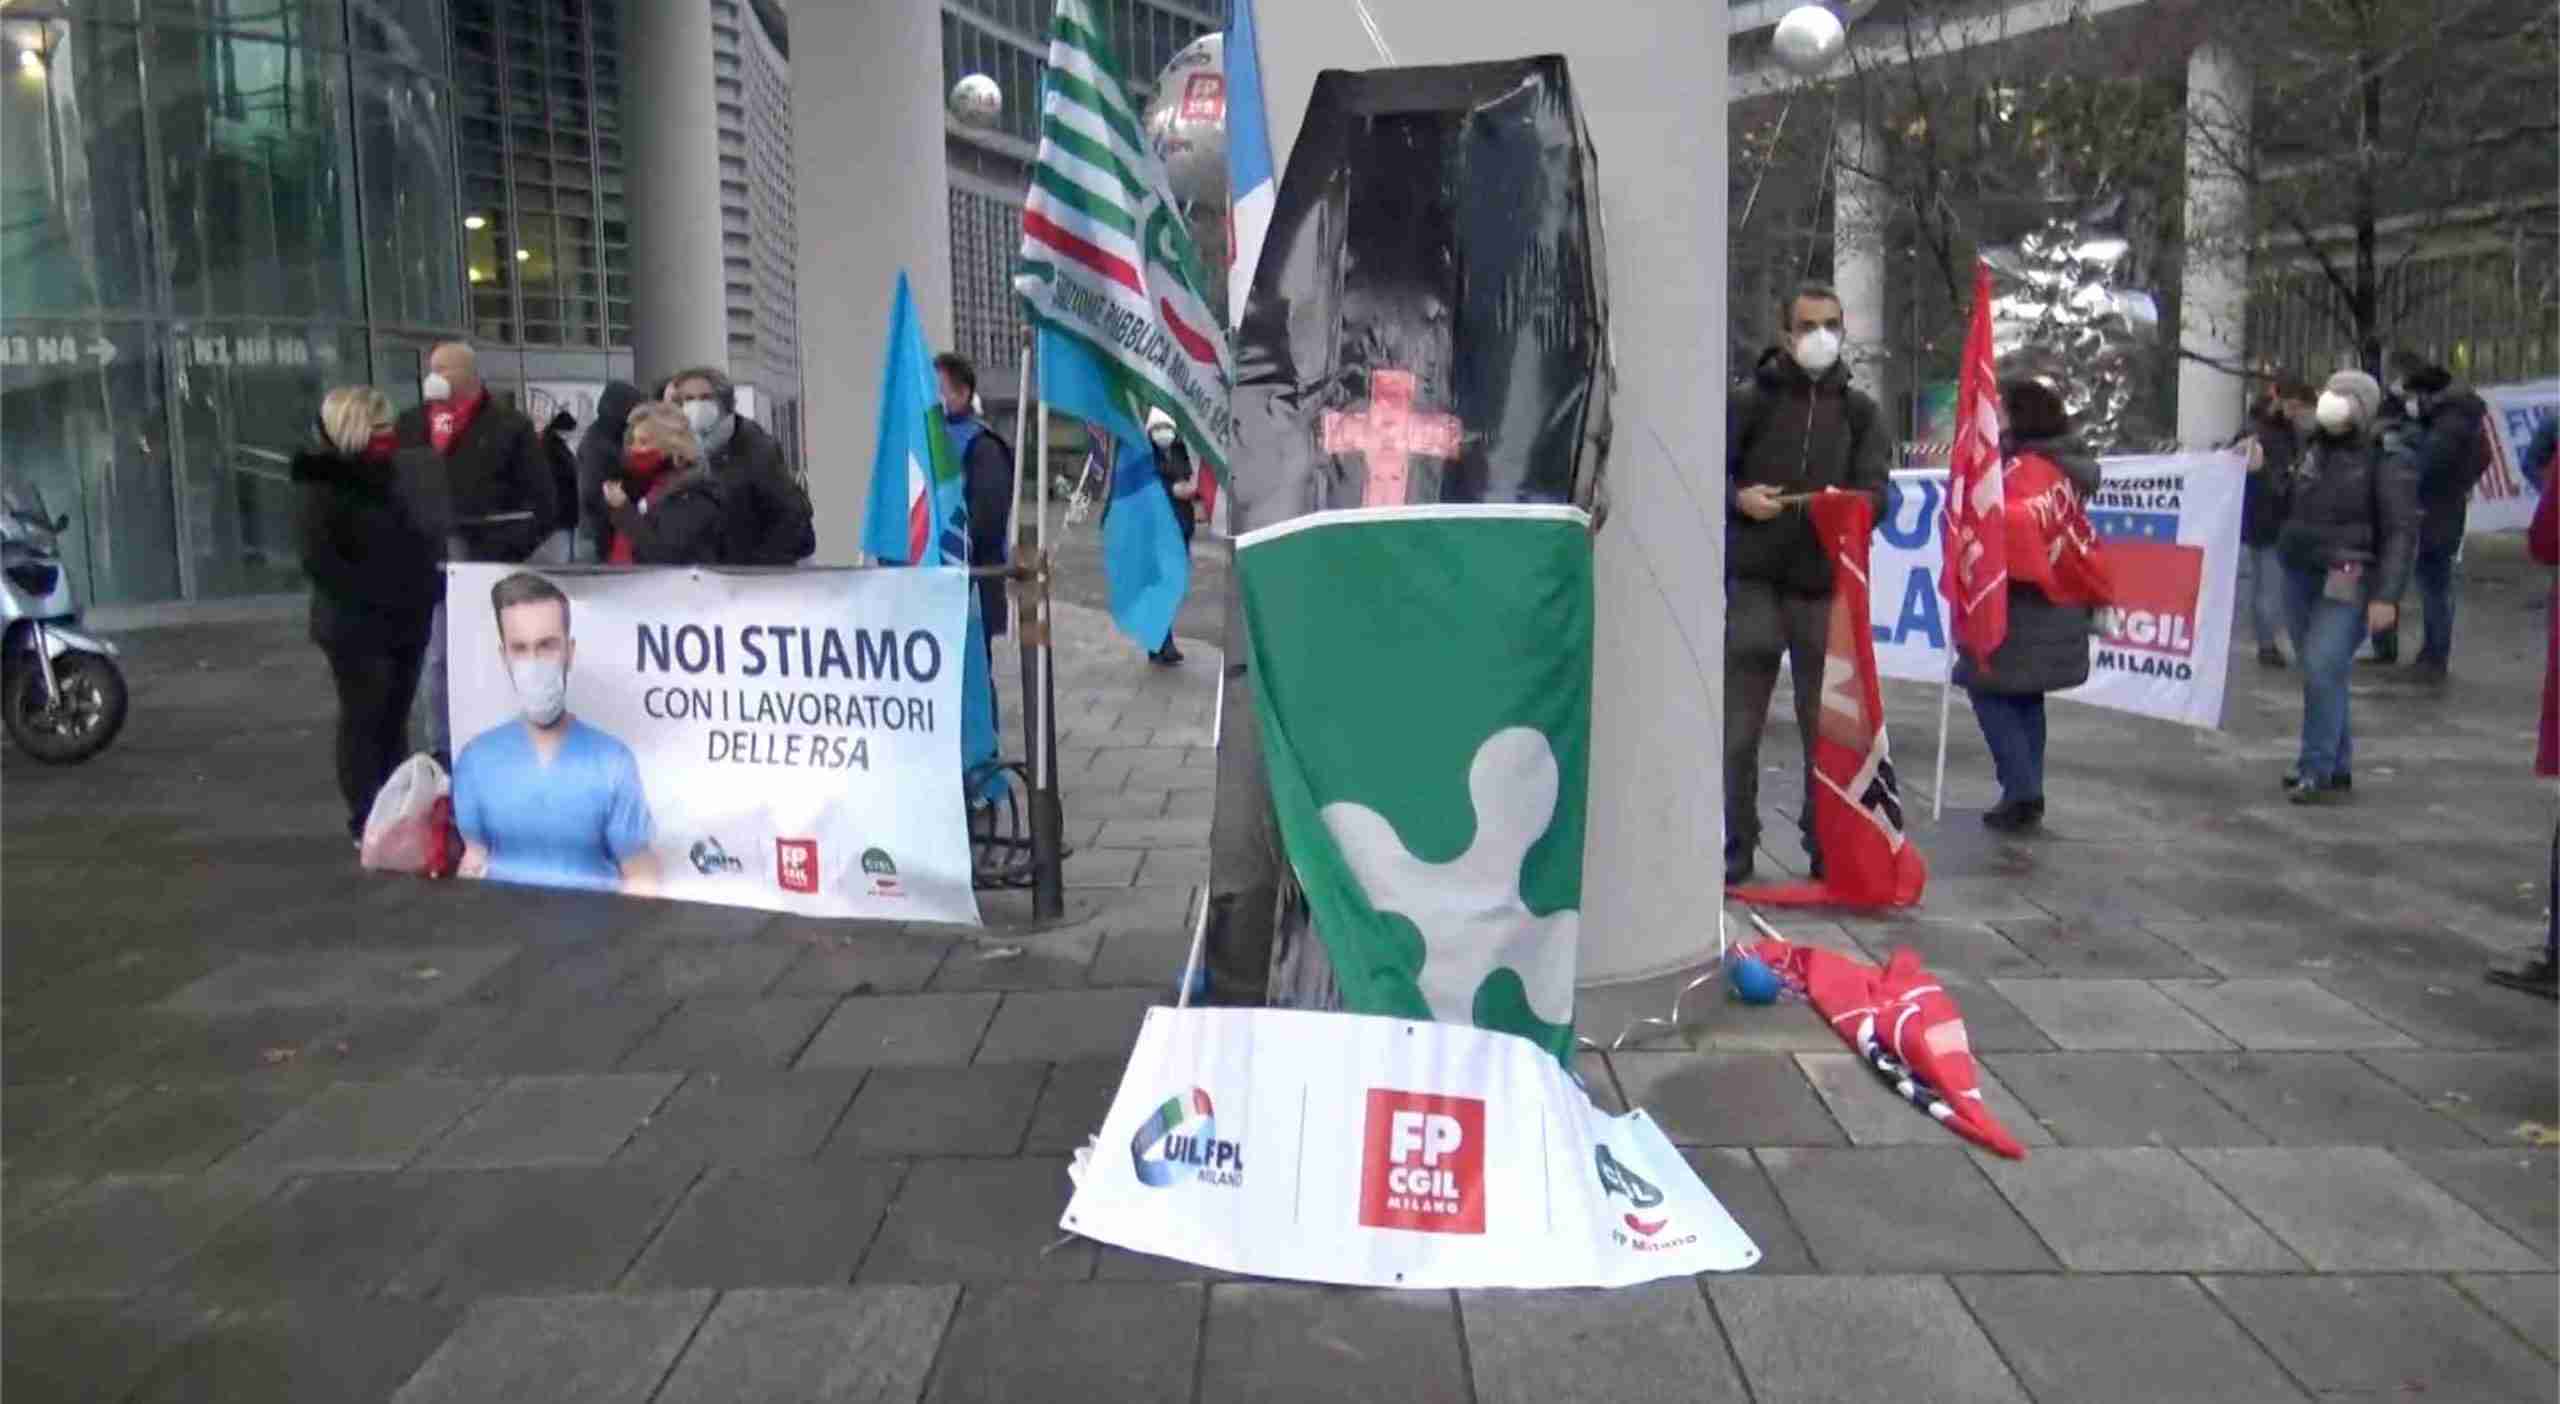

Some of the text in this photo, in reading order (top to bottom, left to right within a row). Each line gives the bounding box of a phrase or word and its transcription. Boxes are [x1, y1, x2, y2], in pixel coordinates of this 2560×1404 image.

[1105, 302, 1171, 368] PUBBLICA
[636, 624, 942, 683] NOI STIAMO
[2096, 651, 2193, 681] MILANO
[644, 687, 935, 732] CON I LAVORATORI
[707, 731, 870, 770] DELLE RSA
[1389, 1110, 1463, 1167] FP
[1388, 1167, 1460, 1199] CGIL
[1386, 1196, 1459, 1215] MILANO
